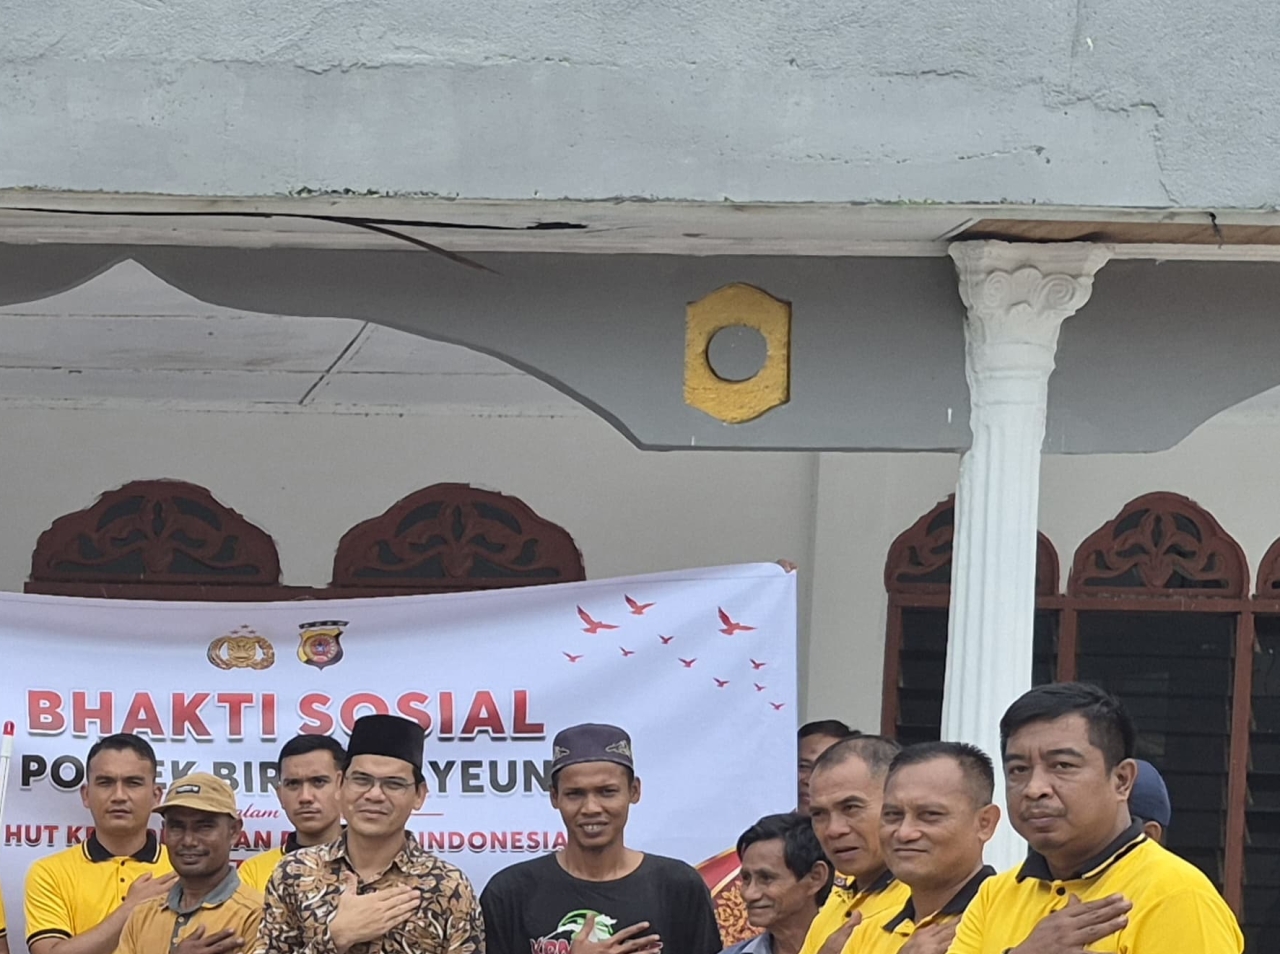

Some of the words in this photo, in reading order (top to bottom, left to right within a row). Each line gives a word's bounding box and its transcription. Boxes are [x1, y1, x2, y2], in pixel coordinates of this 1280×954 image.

[27, 689, 276, 739] BHAKTI
[297, 689, 546, 737] SOSIAL
[21, 754, 197, 790] POEK
[236, 803, 279, 818] alam
[4, 824, 59, 845] HUT
[420, 830, 568, 851] INDONESIA
